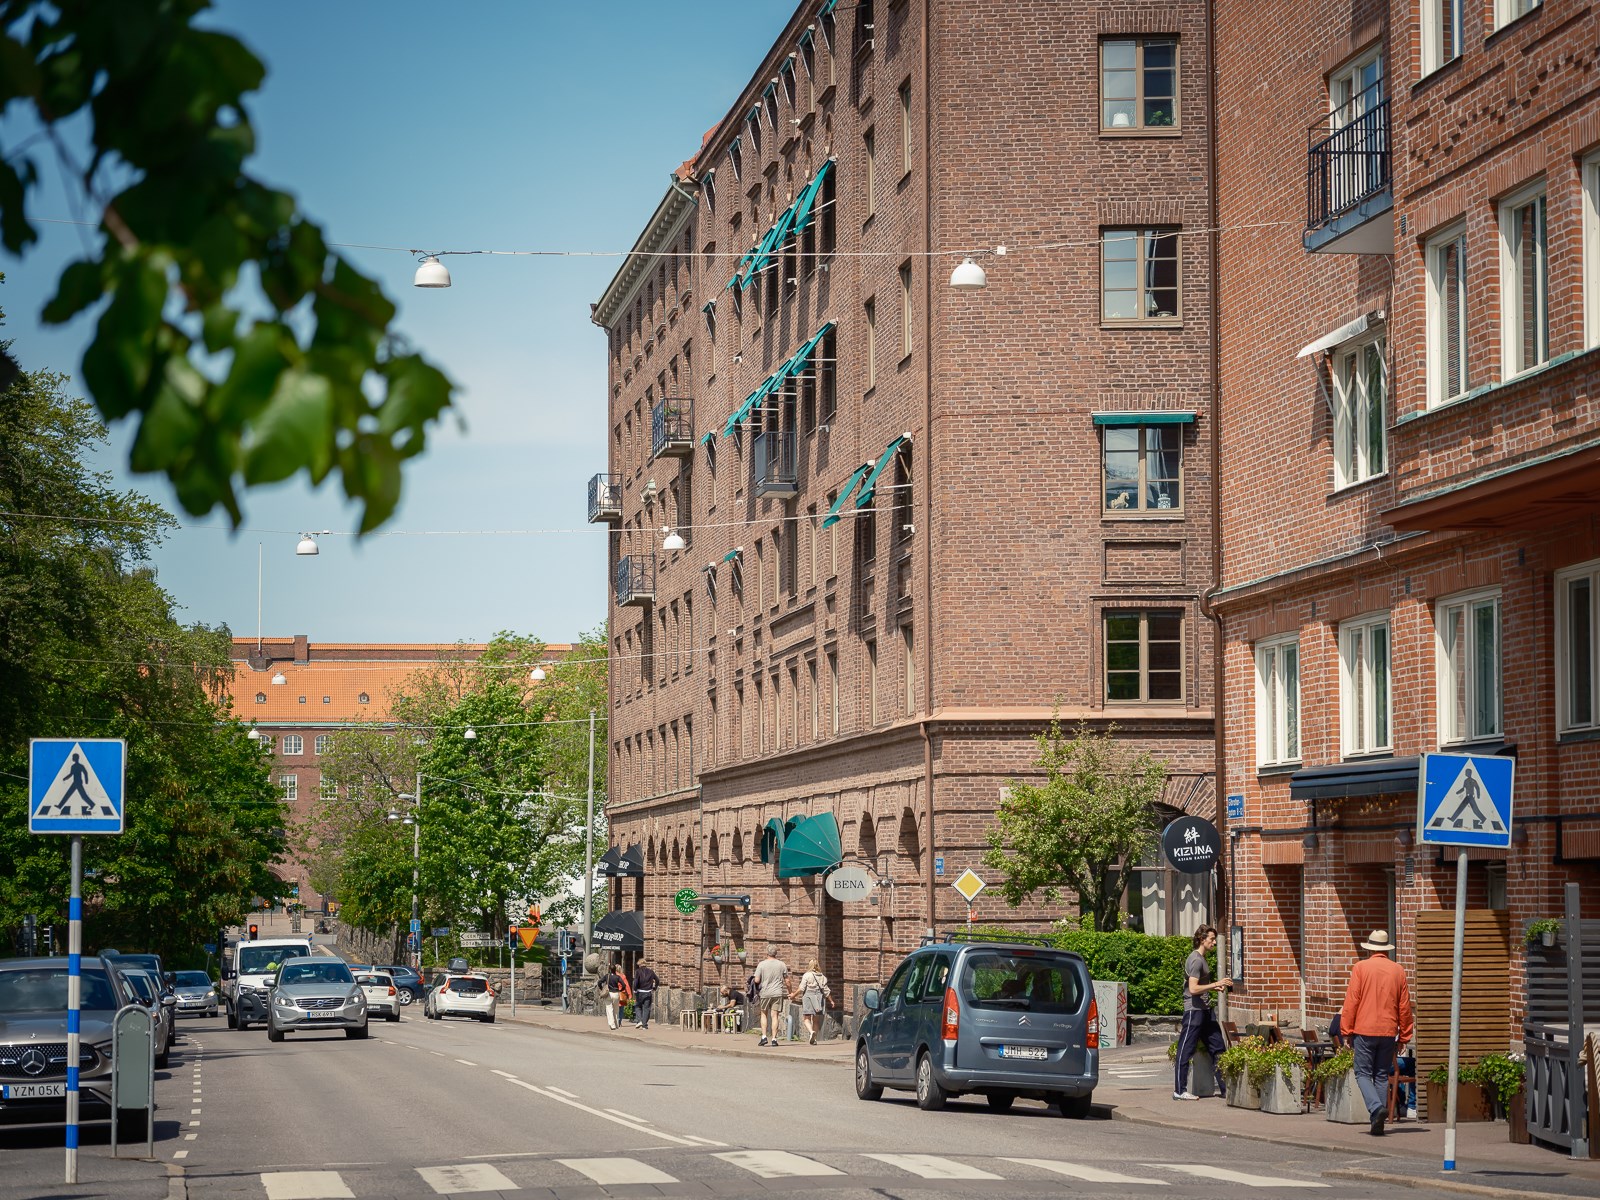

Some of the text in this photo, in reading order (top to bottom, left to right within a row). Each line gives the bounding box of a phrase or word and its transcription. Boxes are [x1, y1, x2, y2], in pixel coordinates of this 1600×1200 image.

[1184, 826, 1200, 845] 絆
[1173, 845, 1213, 857] KIZUNA
[834, 880, 865, 889] BENA
[1005, 1047, 1046, 1056] JMH 522
[13, 1085, 35, 1096] YZM
